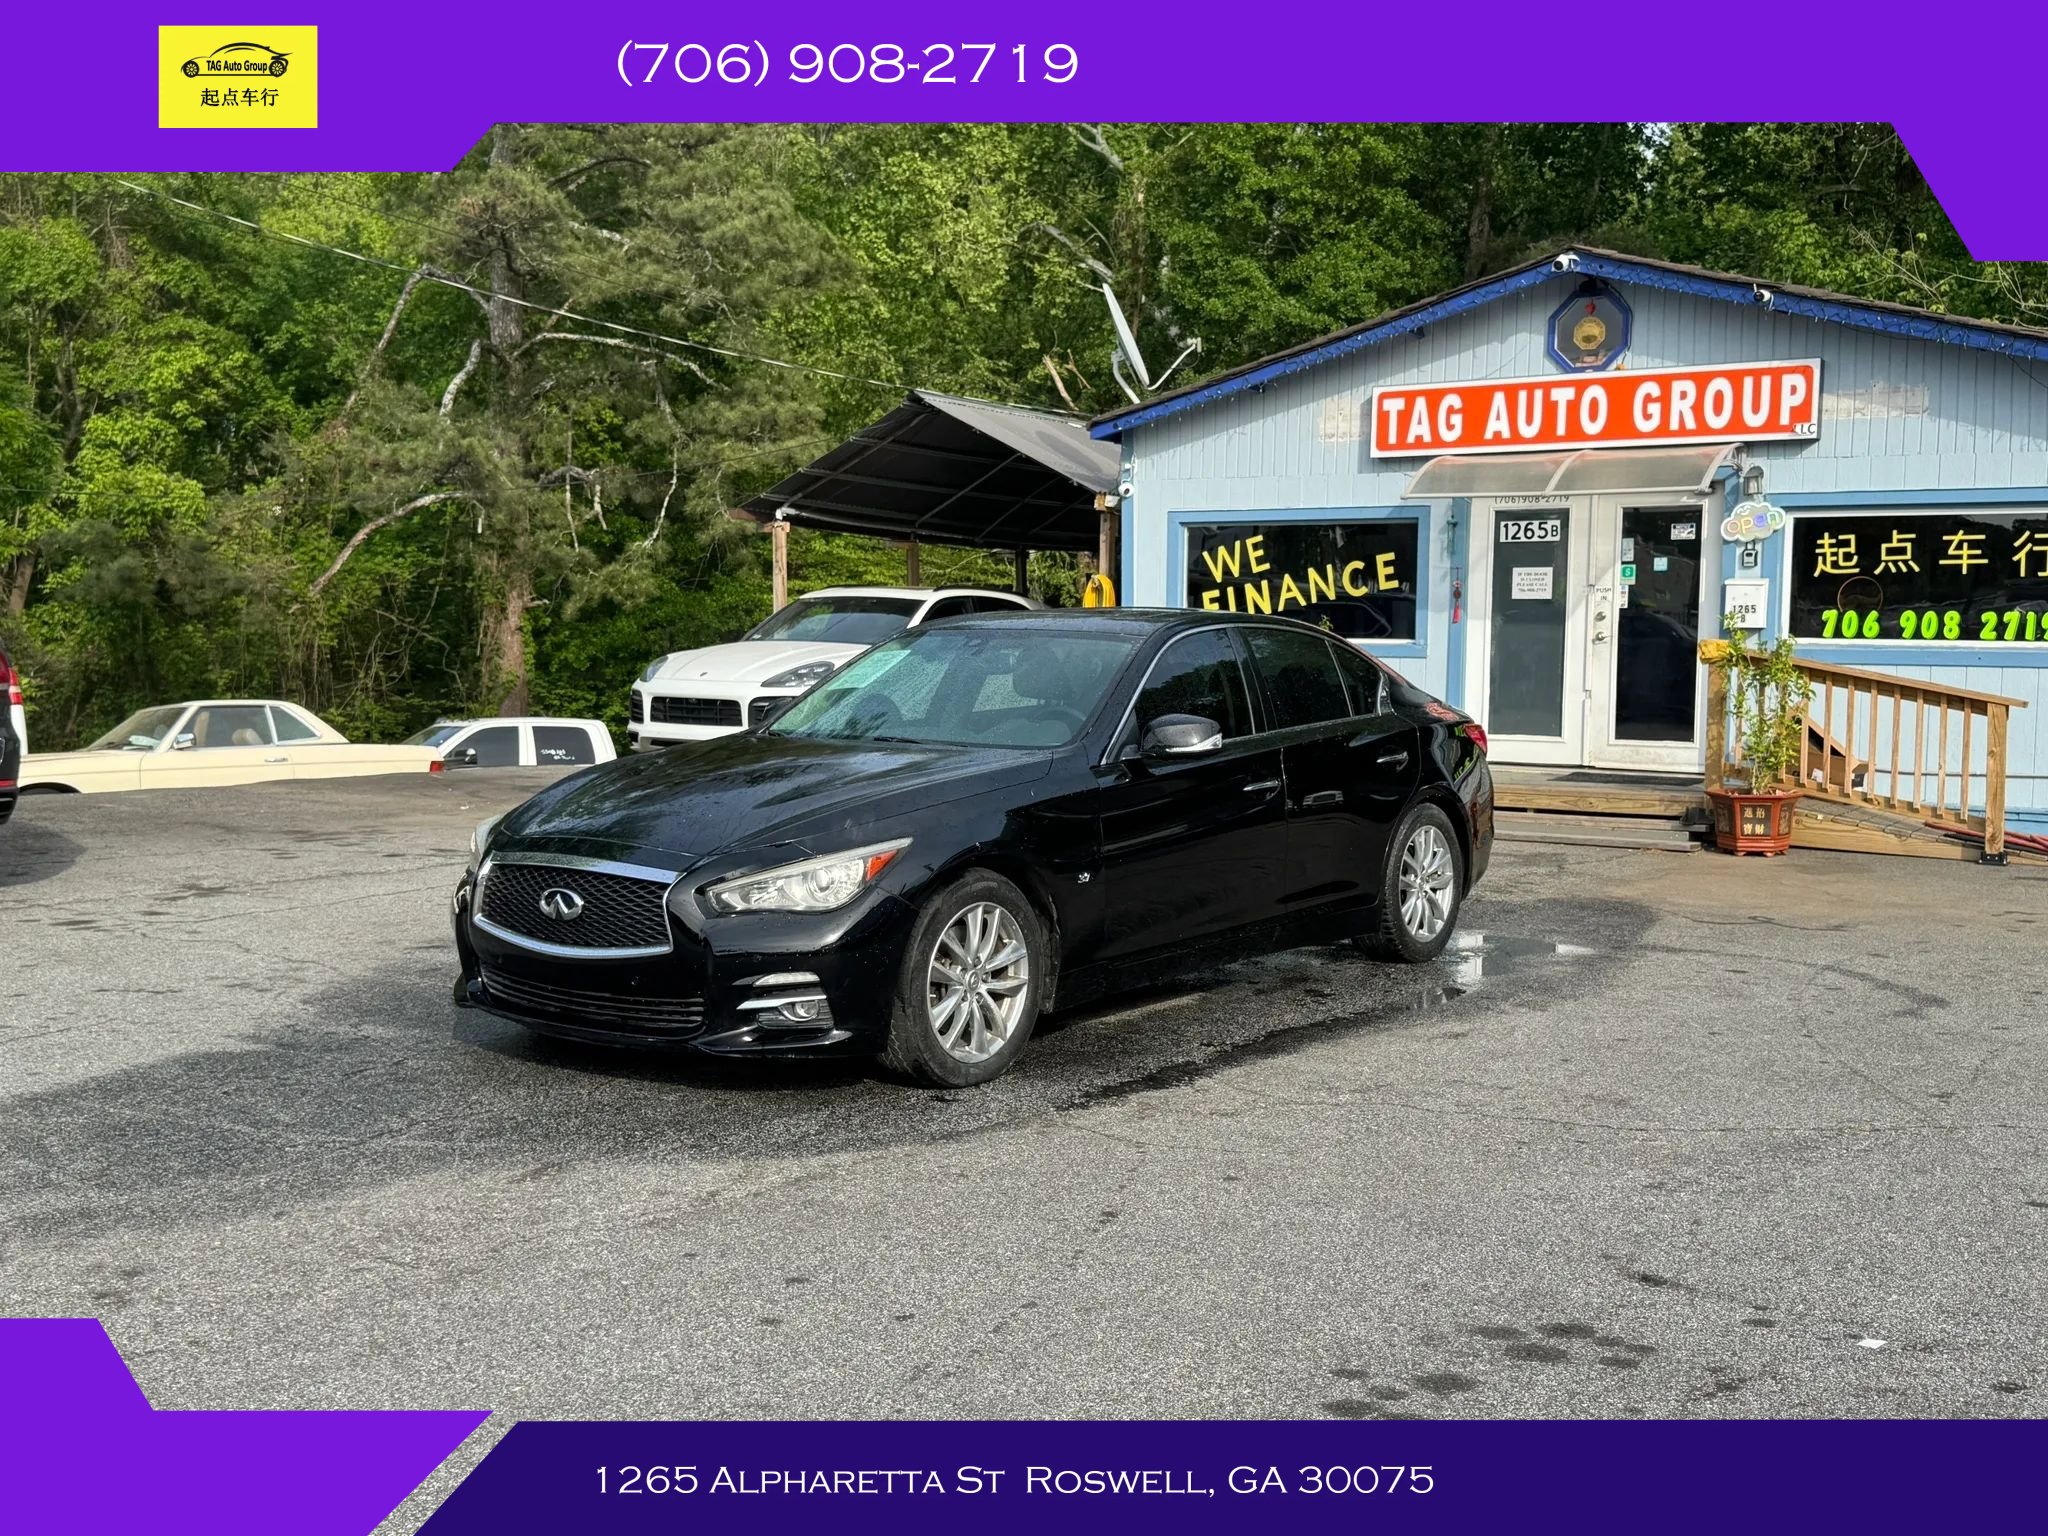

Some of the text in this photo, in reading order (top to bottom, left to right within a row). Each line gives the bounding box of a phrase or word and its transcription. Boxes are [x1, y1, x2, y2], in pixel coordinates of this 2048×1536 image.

[1382, 373, 1808, 445] TAG AUTO GROUP
[1792, 423, 1816, 435] LLC
[1202, 534, 1271, 584] WE
[1813, 529, 2048, 578] 起点车行
[1201, 552, 1399, 615] FINANCE
[1732, 605, 1757, 614] 1265
[1822, 609, 1880, 638] 706
[1899, 610, 1961, 639] 908
